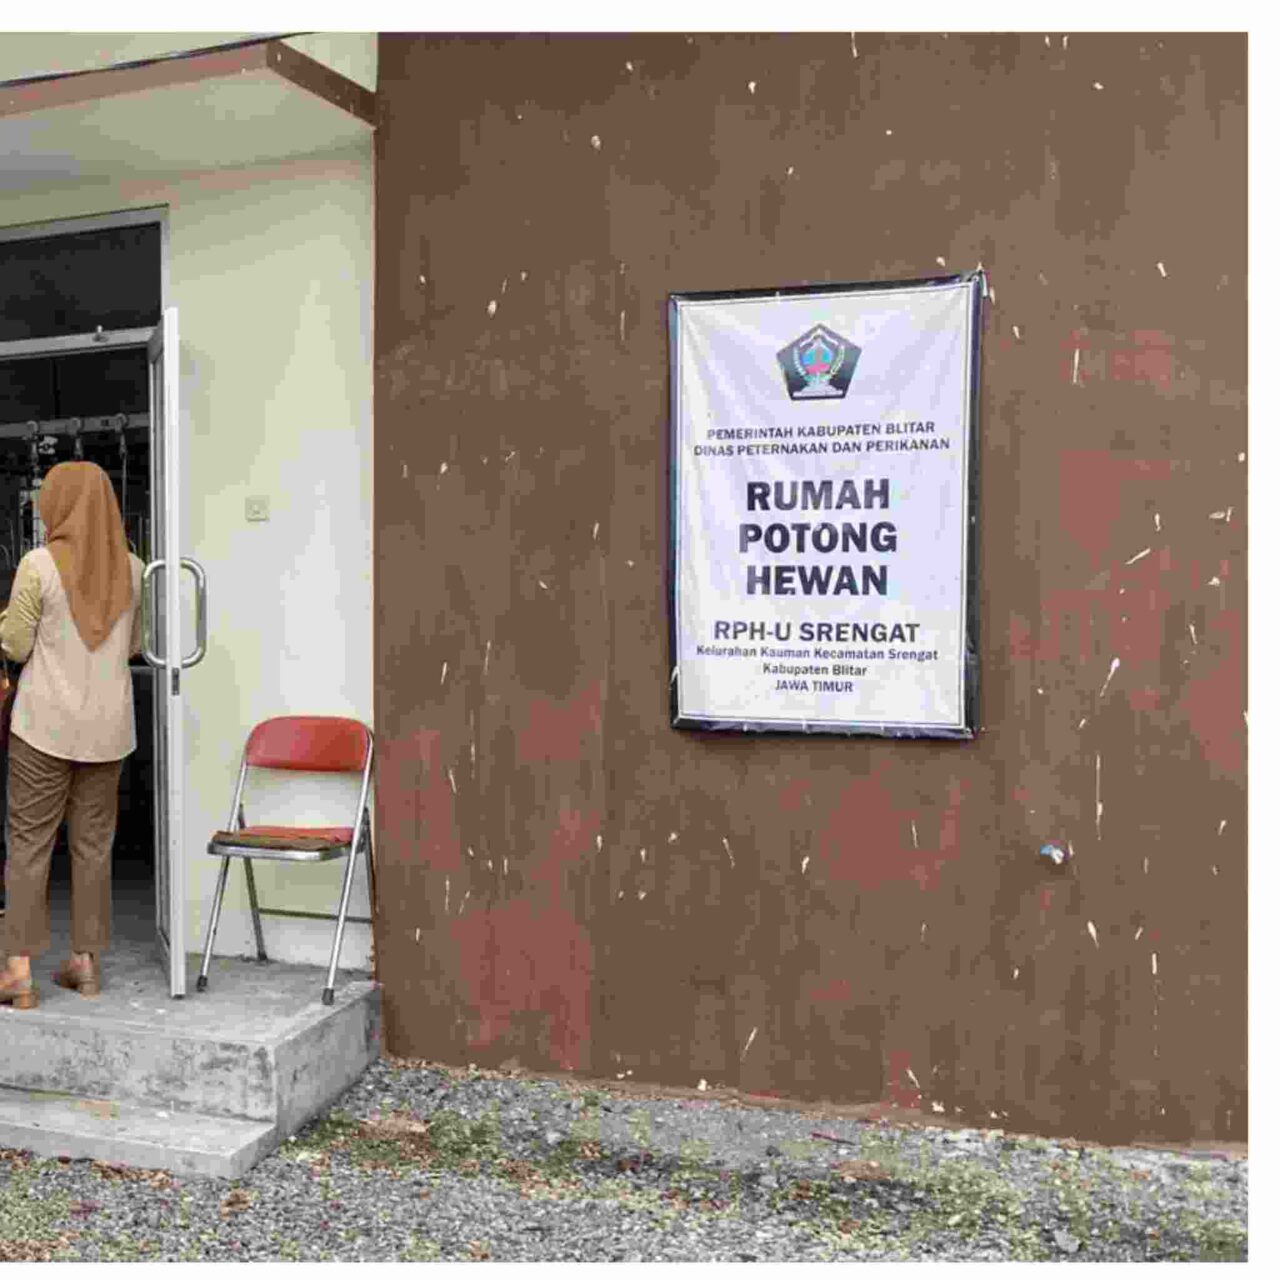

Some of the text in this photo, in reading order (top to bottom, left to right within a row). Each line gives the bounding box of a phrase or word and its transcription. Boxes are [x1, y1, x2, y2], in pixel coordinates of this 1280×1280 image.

[707, 421, 935, 440] PEMERINTAH KABUPATEN BLITAR
[694, 438, 950, 457] DINAS PETERNAKAN DAN PERIKANAN
[746, 478, 890, 511] RUMAH
[739, 520, 898, 554] POTONG
[746, 564, 889, 596] HEWAN
[714, 620, 920, 643] RPH-U SRENGAT
[696, 644, 938, 662] Kelurahan Kauman Kecamatan Srengat
[763, 663, 867, 677] Kabupaten Blitar
[775, 680, 853, 693] JAWA TIMUR
